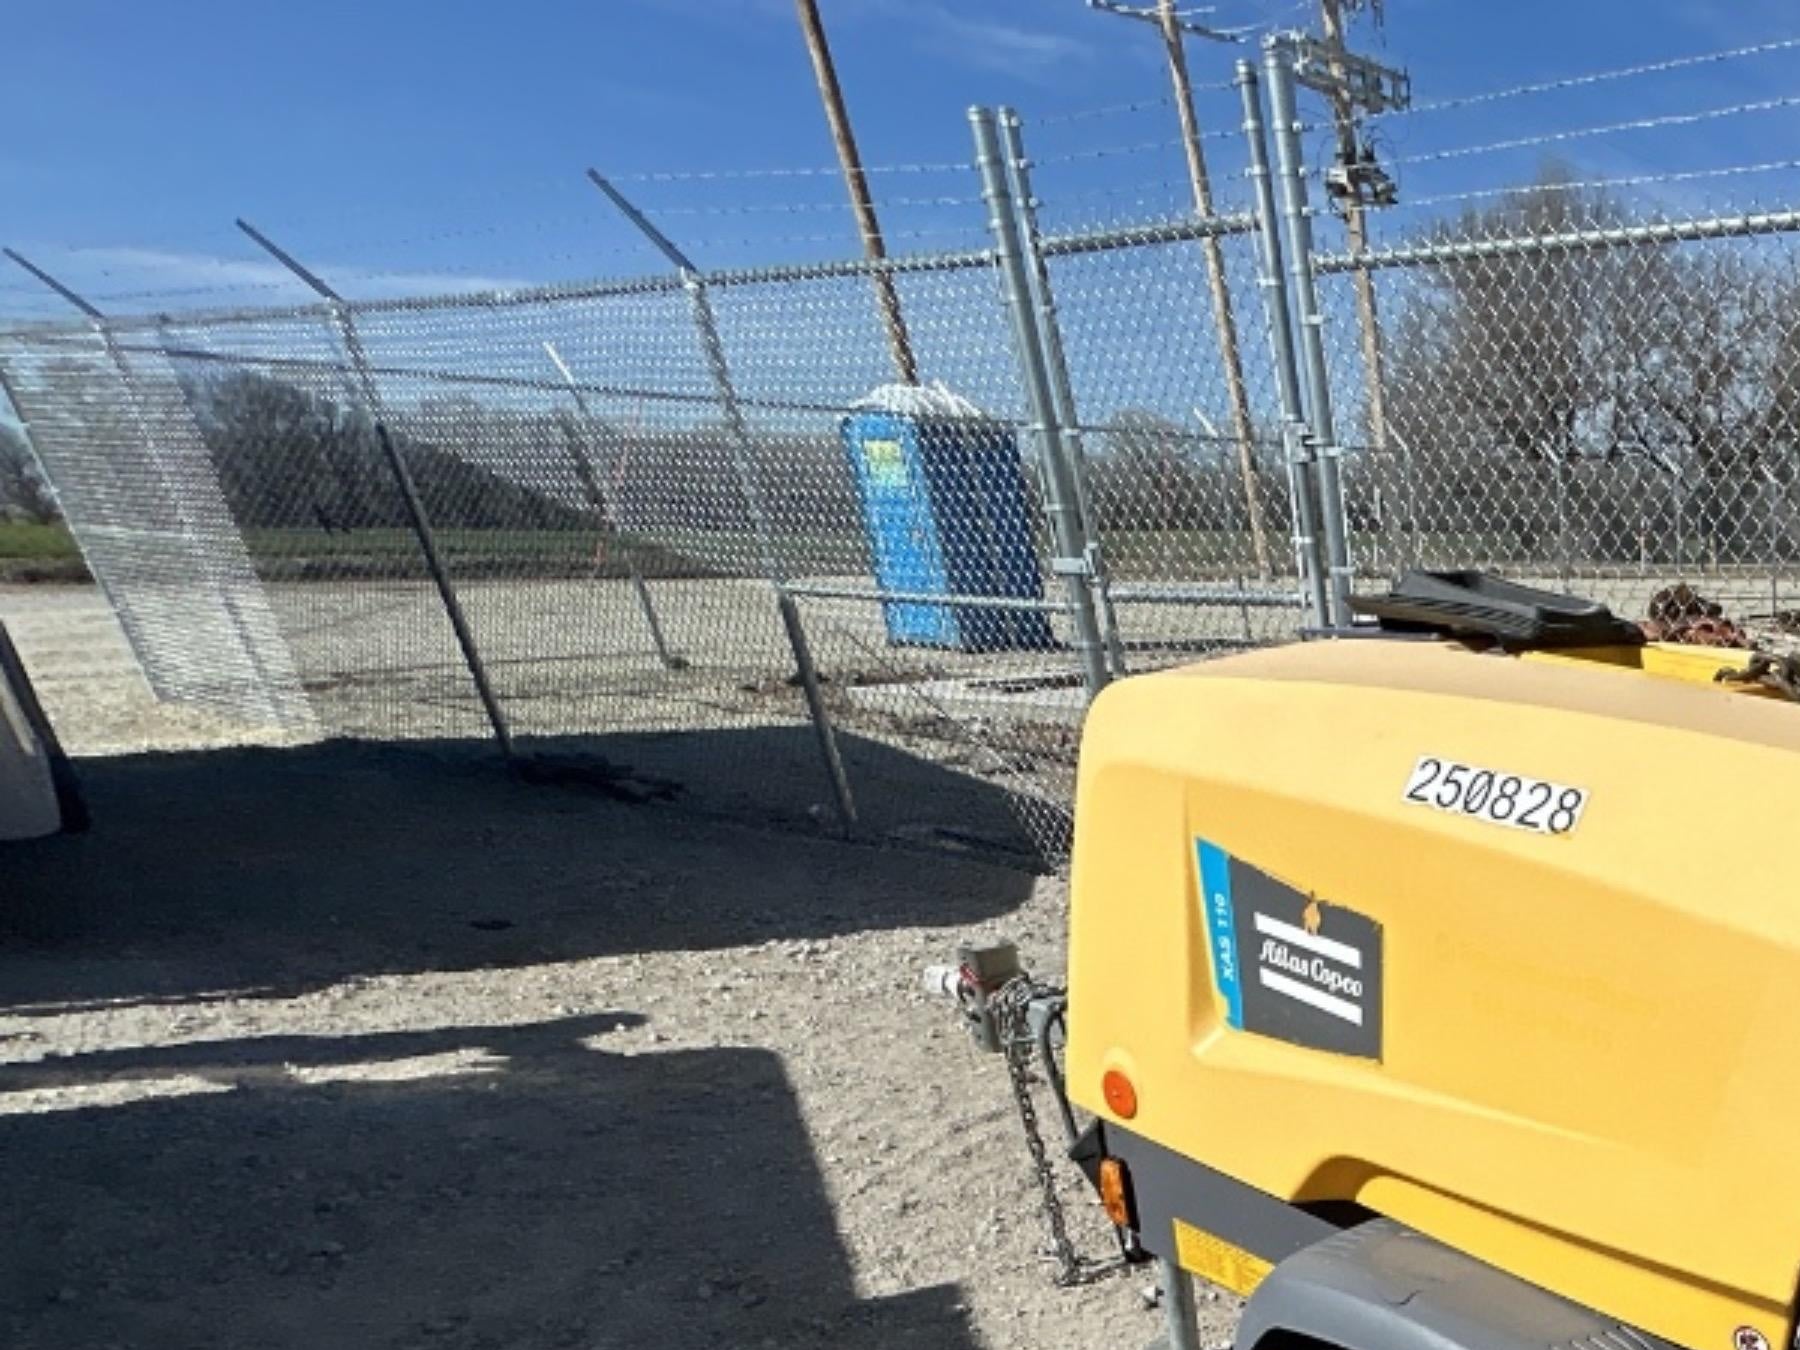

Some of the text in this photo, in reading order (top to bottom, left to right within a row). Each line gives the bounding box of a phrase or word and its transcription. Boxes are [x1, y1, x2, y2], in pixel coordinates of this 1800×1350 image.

[1405, 757, 1583, 835] 250828
[1258, 938, 1363, 998] Atlas Copco
